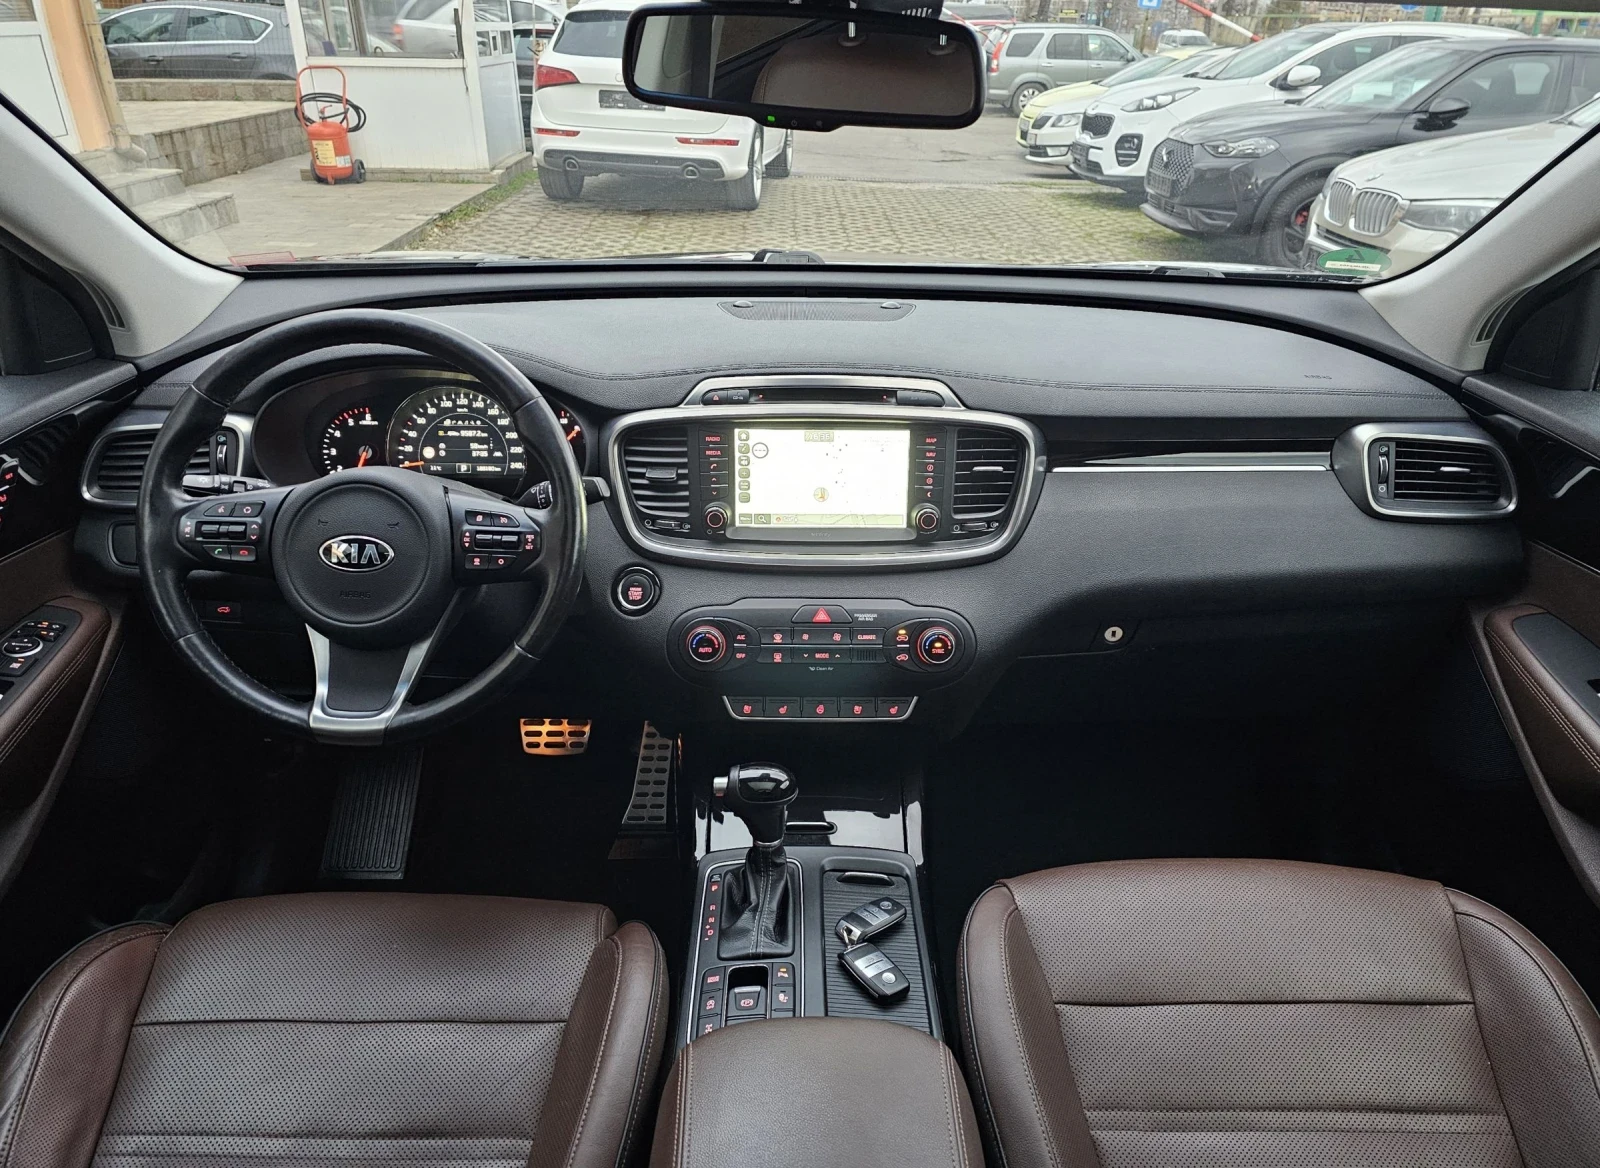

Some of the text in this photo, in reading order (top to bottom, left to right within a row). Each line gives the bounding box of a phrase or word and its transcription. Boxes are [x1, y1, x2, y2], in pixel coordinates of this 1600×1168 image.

[440, 400, 453, 408] 100
[427, 407, 437, 415] 80
[487, 408, 500, 416] 160
[365, 413, 372, 421] 6
[416, 417, 427, 425] 60
[347, 418, 355, 427] 5
[497, 418, 510, 426] 180
[333, 430, 341, 438] 4
[407, 430, 418, 438] 40
[505, 432, 518, 440] 200
[329, 447, 337, 456] 3
[509, 446, 522, 454] 220
[460, 464, 468, 473] P
[509, 462, 522, 470] 240
[331, 543, 381, 564] KIA
